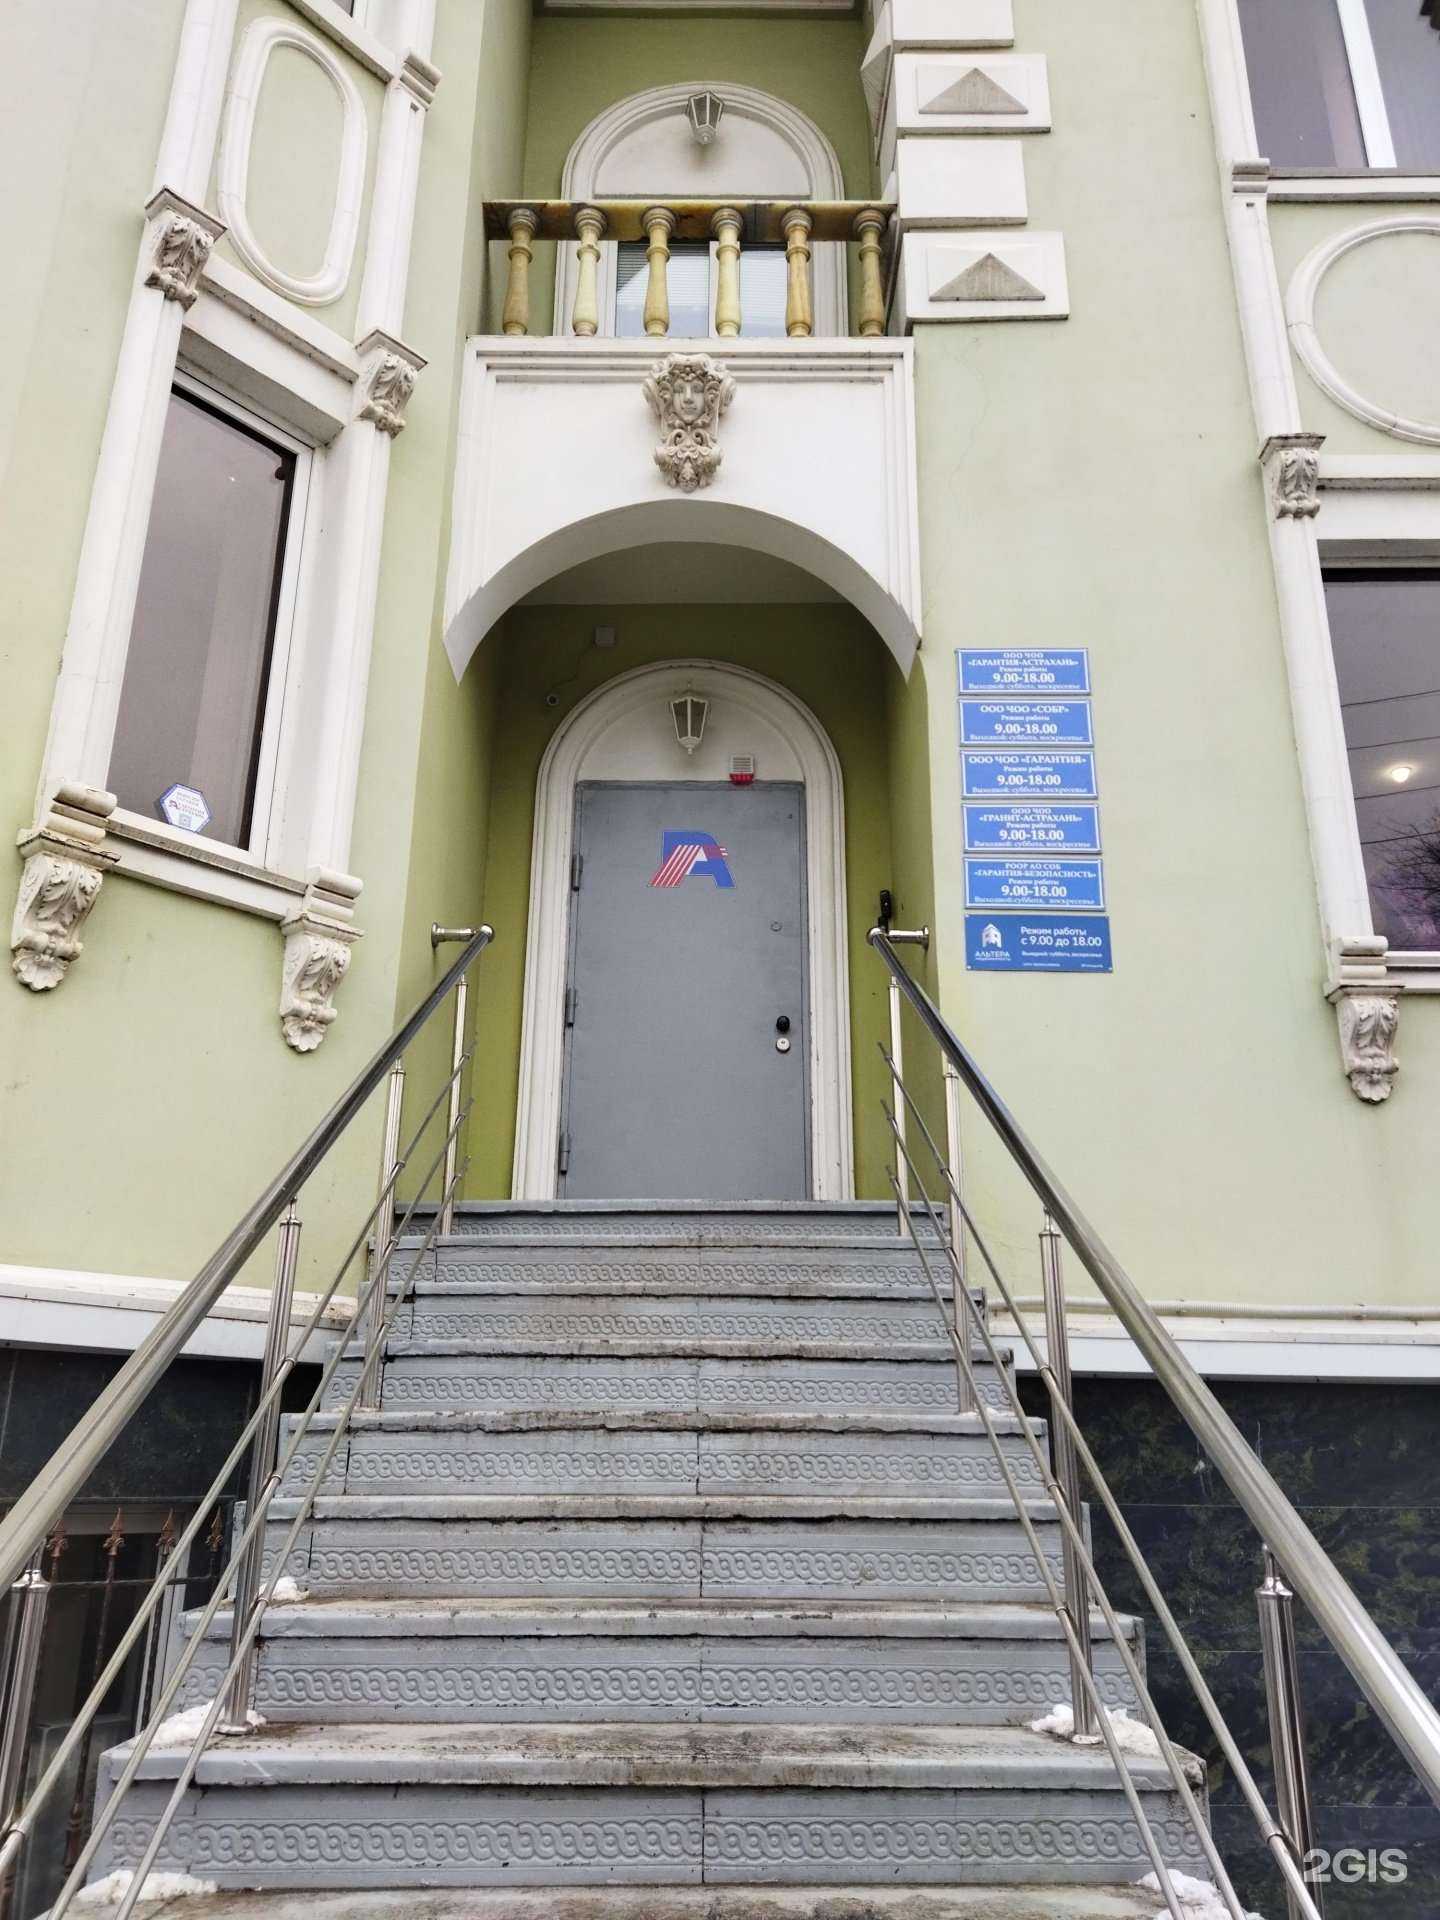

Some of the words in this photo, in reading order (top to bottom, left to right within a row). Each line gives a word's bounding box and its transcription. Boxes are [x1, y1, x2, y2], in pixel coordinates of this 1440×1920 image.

[993, 673, 1055, 683] 9.00-18.00
[980, 705, 1004, 713] ООО
[1006, 705, 1029, 713] ЧОО
[994, 723, 1058, 734] 9.00-18.00
[969, 756, 993, 764] ООО
[996, 756, 1019, 764] ЧОО
[1021, 756, 1087, 764] «ГАРАНТИЯ»
[997, 774, 1061, 785] 9.00-18.00
[979, 814, 1083, 822] «ГРАНИТ-АСТРАХАНЬ»
[1000, 830, 1064, 841] 9.00-18.00
[1001, 885, 1067, 897] 9.00-18.00
[1020, 926, 1052, 935] Режим
[1053, 926, 1087, 936] работы
[1020, 937, 1028, 945] с
[1029, 935, 1053, 946] 9.00
[1055, 938, 1070, 948] до
[1073, 936, 1102, 947] 18.00
